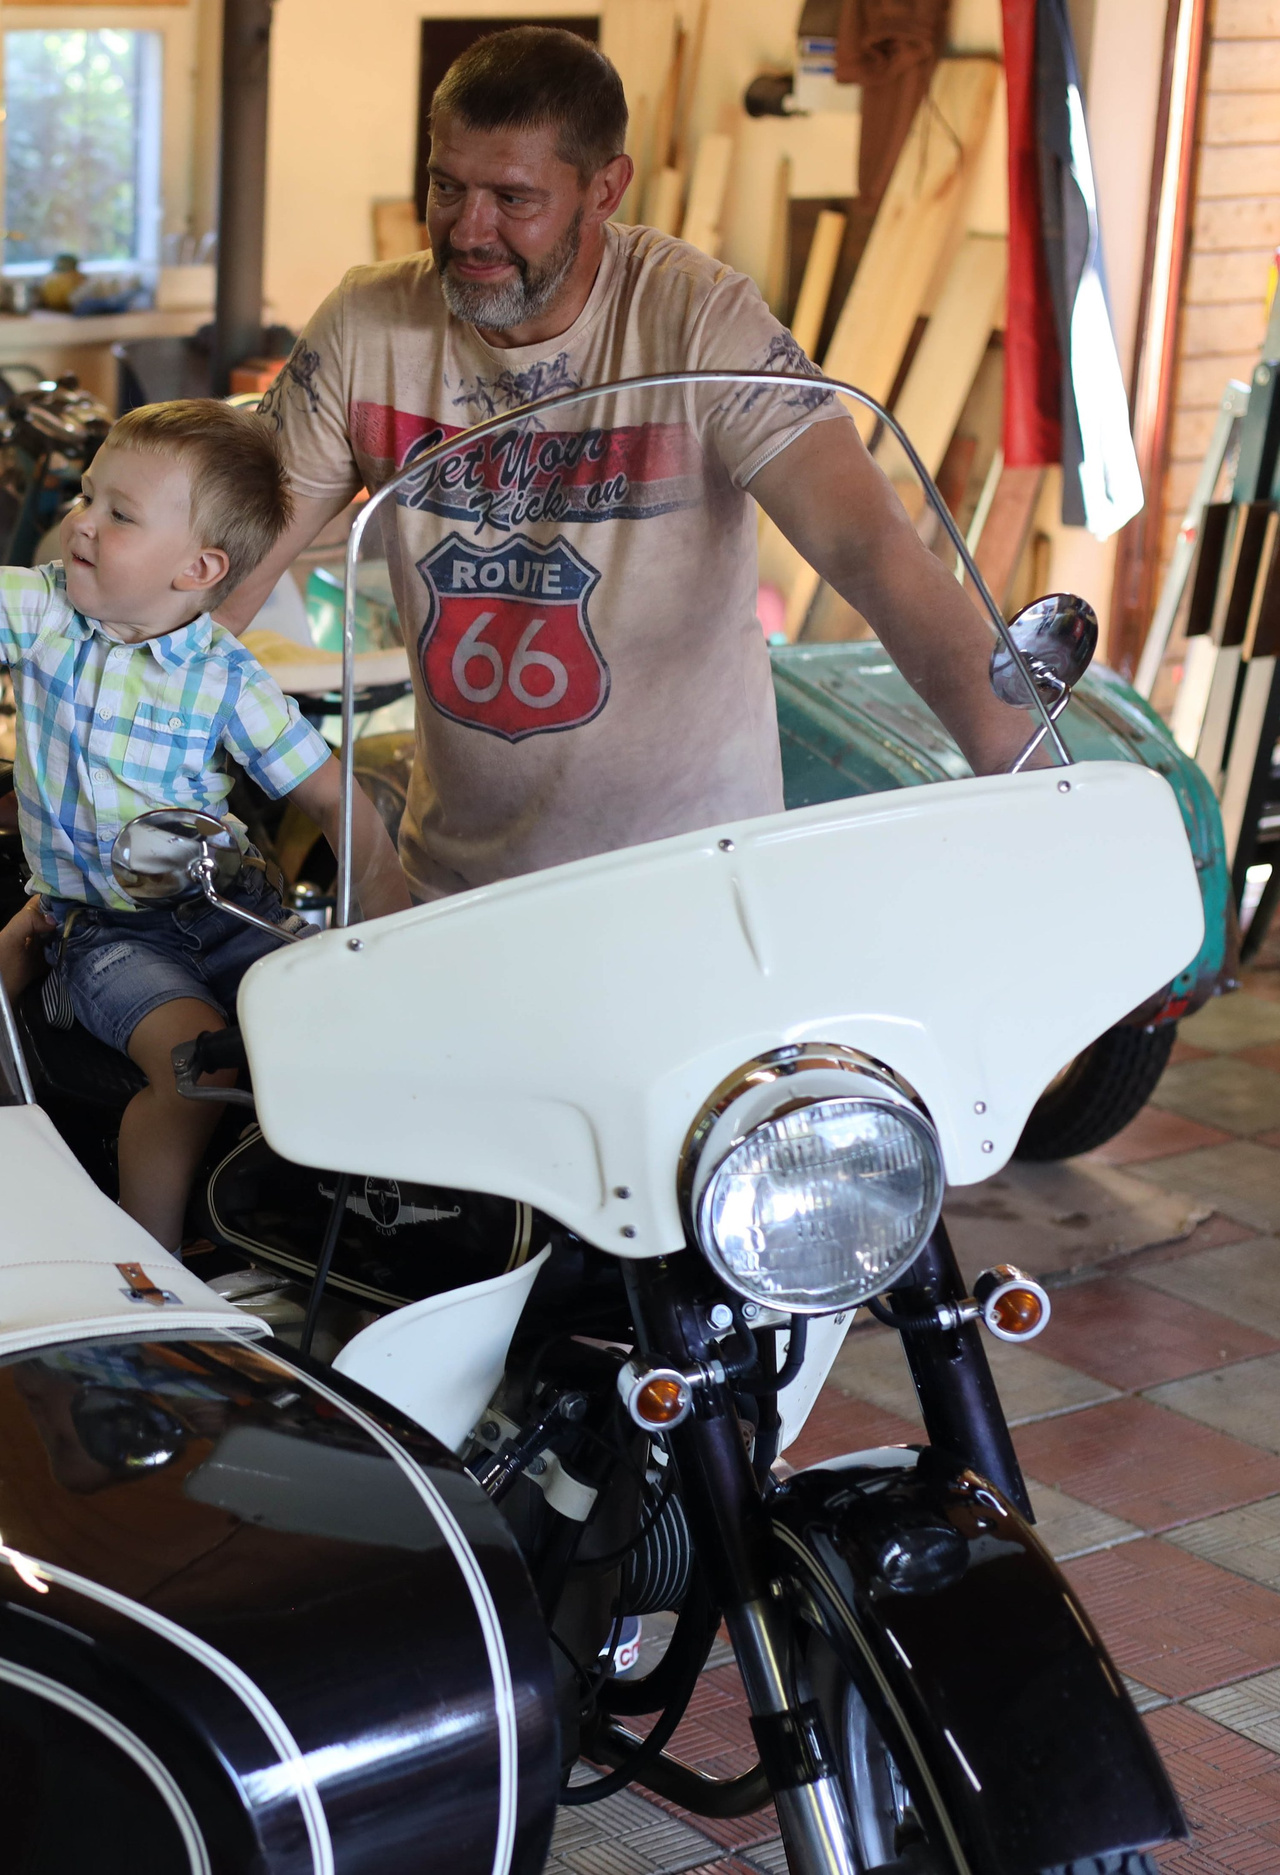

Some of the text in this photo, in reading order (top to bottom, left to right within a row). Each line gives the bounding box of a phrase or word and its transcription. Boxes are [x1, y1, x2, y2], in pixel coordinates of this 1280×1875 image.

[399, 428, 606, 509] Get Your
[586, 473, 629, 509] on
[451, 559, 563, 595] ROUTE
[451, 611, 569, 709] 66
[376, 1225, 397, 1236] CLUB
